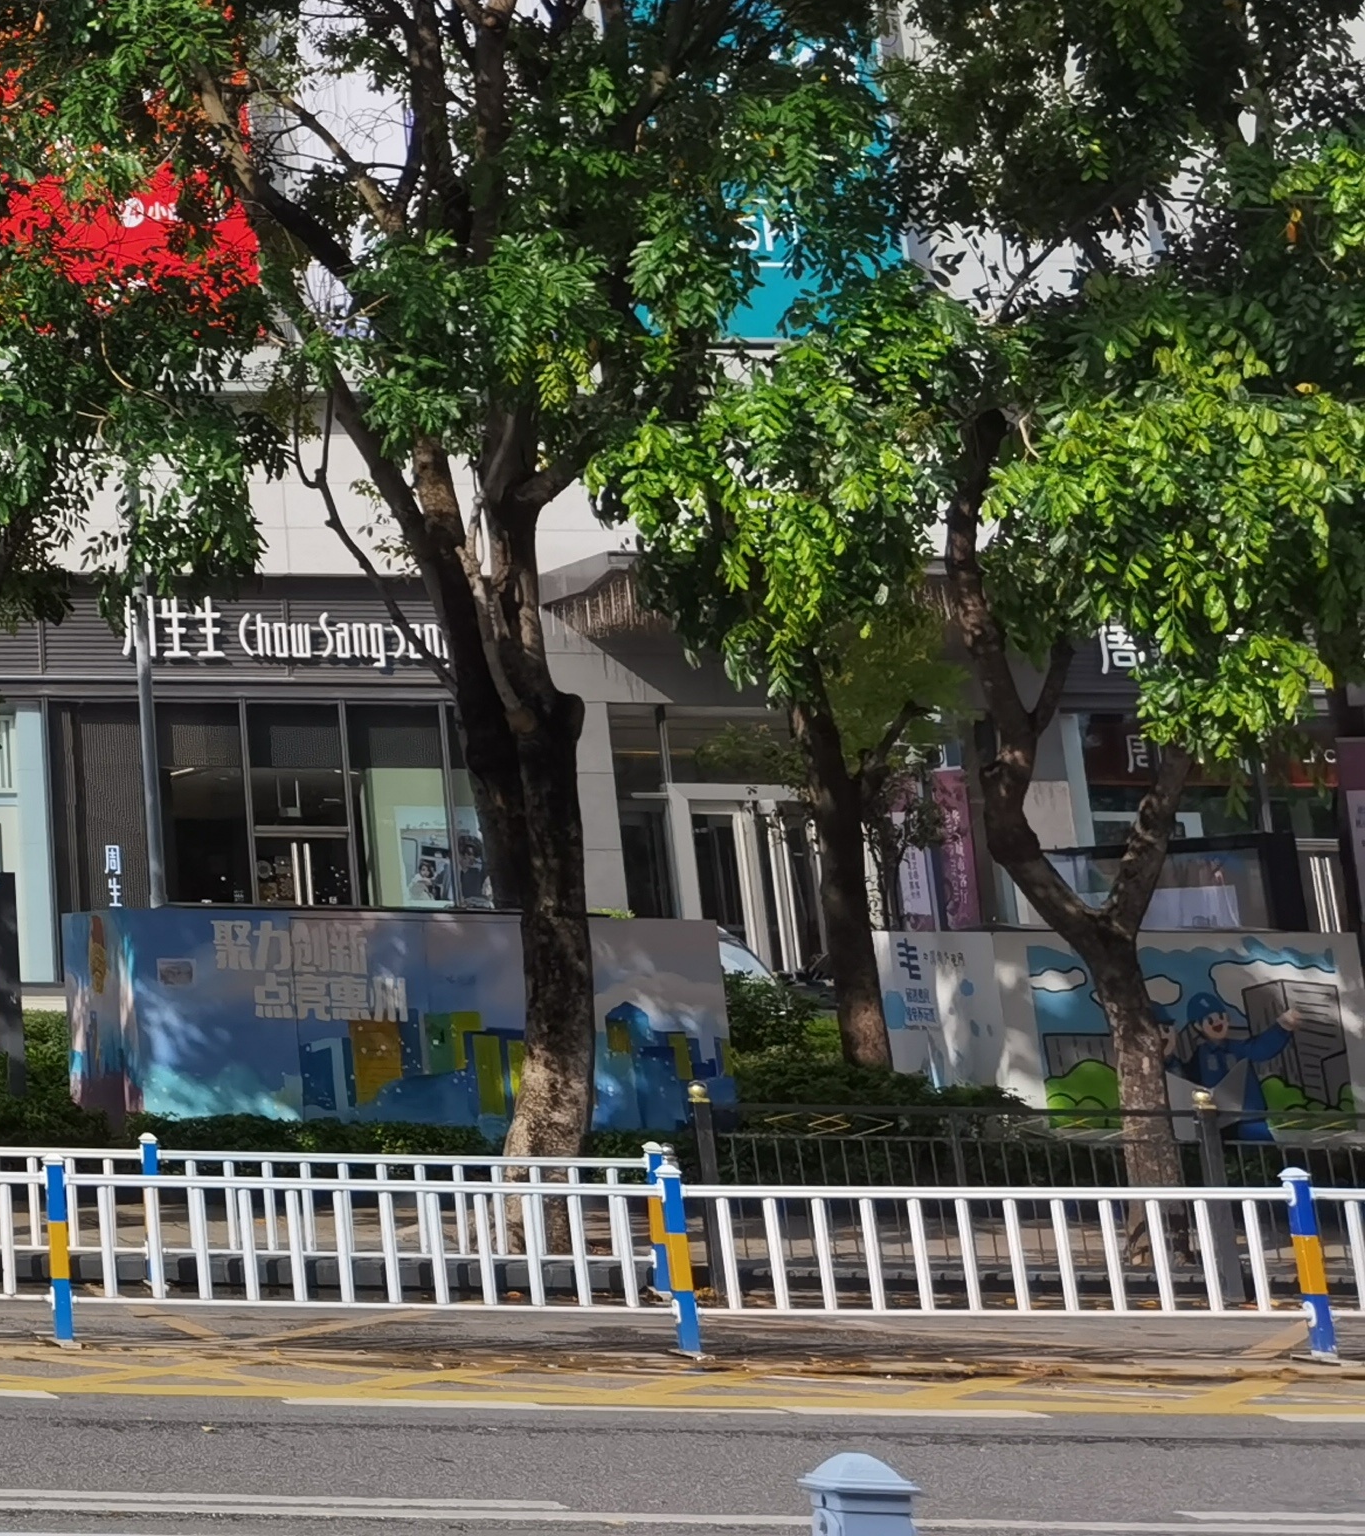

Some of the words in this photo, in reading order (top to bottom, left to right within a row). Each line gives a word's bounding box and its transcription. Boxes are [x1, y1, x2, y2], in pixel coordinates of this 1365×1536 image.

[238, 612, 312, 658] Chow
[318, 611, 387, 668] Sang
[210, 919, 368, 975] 聚力创新
[253, 973, 409, 1023] 点亮惠州
